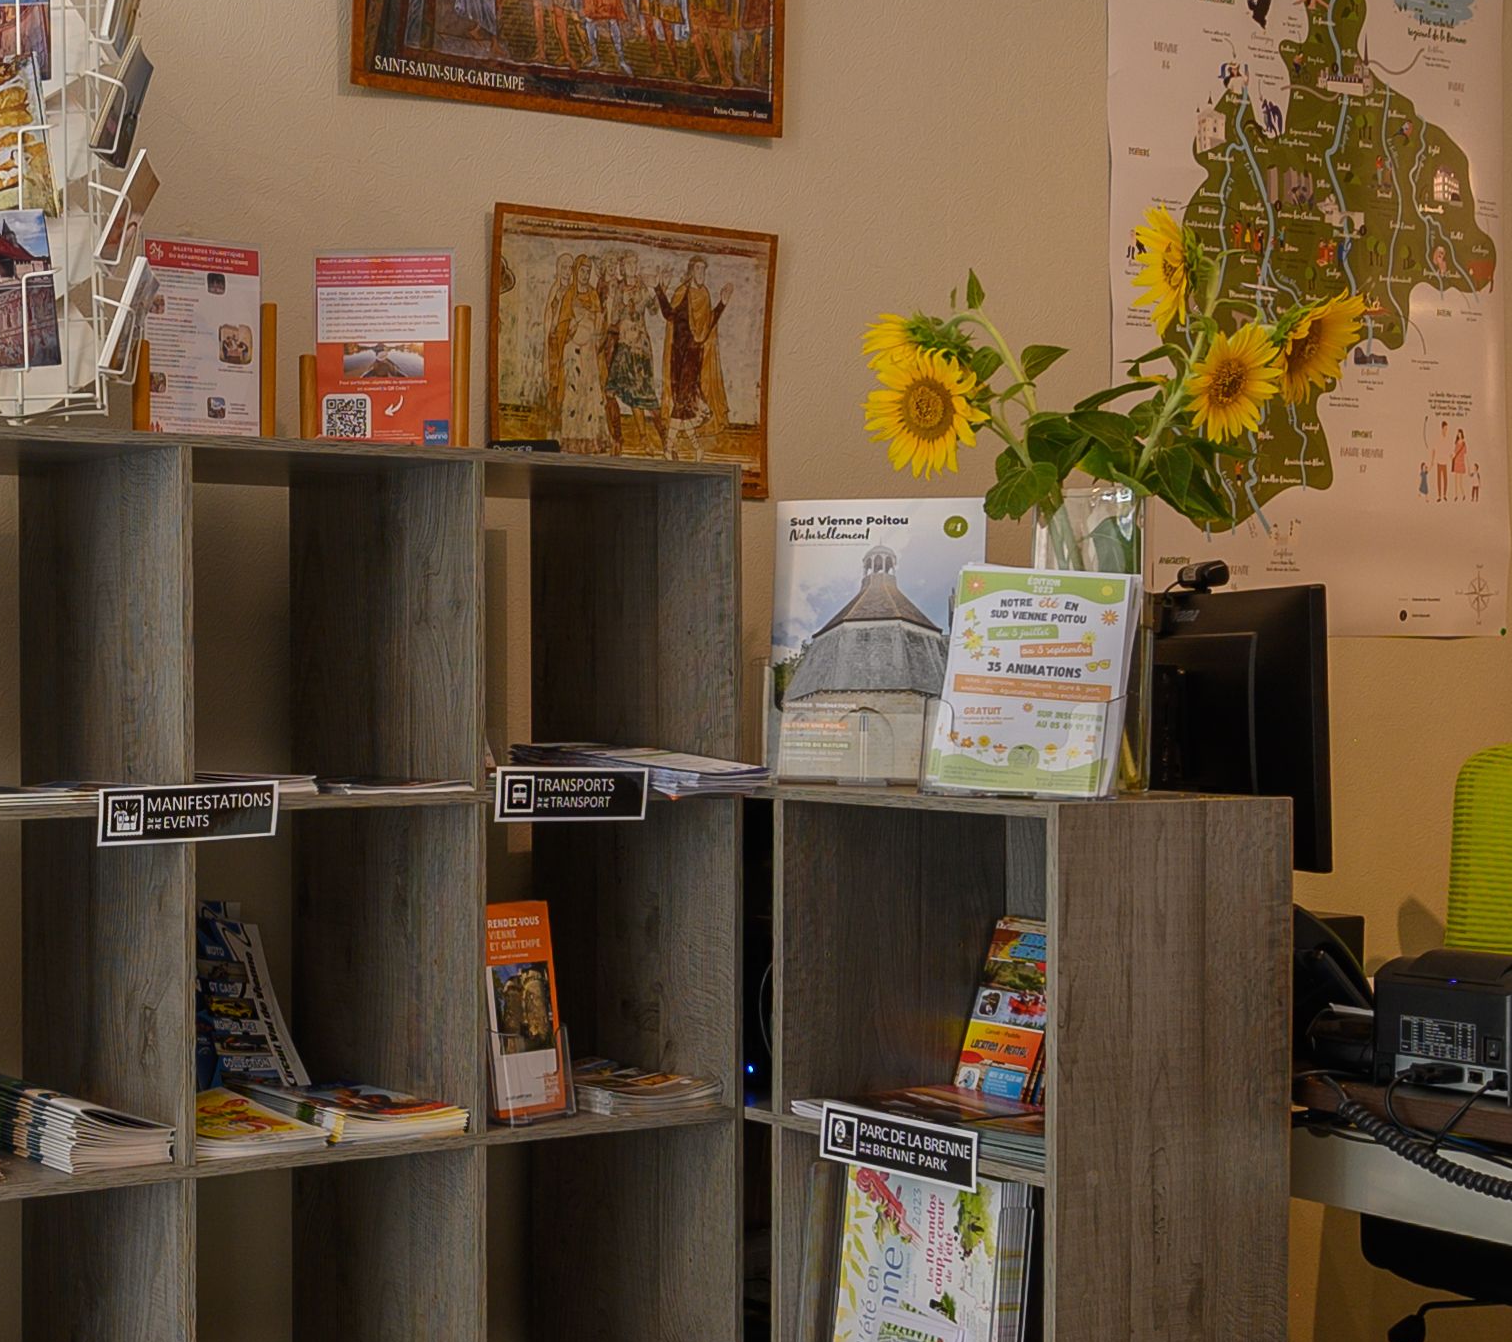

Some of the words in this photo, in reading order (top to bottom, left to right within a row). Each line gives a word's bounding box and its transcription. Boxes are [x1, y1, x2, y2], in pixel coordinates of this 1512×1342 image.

[374, 55, 525, 92] SAINT-SAVIN-SUR-GARTEMPE
[790, 516, 815, 527] Sud
[818, 516, 863, 527] Vienne
[866, 515, 909, 527] Poitou
[947, 521, 963, 533] #1
[789, 527, 870, 543] Naturellement
[1000, 598, 1033, 609] NOTRE
[1065, 601, 1079, 611] EN
[990, 609, 1009, 620] SUD
[1012, 610, 1048, 622] VIENNE
[1051, 613, 1087, 625] POITOU
[987, 660, 1003, 674] 35
[1006, 662, 1082, 680] ANIMATIONS
[963, 705, 1002, 716] GRATUIT
[537, 778, 615, 794] TRANSPORTS
[146, 791, 272, 811] MANIFESTATIONS
[550, 795, 611, 809] TRANSPORT
[162, 814, 210, 830] EVENTS
[486, 915, 540, 929] RENDEZ-VOUS
[488, 931, 517, 941] VIENNE
[859, 1121, 889, 1143] PARC
[890, 1131, 907, 1146] DE
[908, 1133, 923, 1146] LA
[924, 1135, 972, 1160] BRENNE
[872, 1143, 916, 1163] BRENNE
[918, 1154, 948, 1172] PARK
